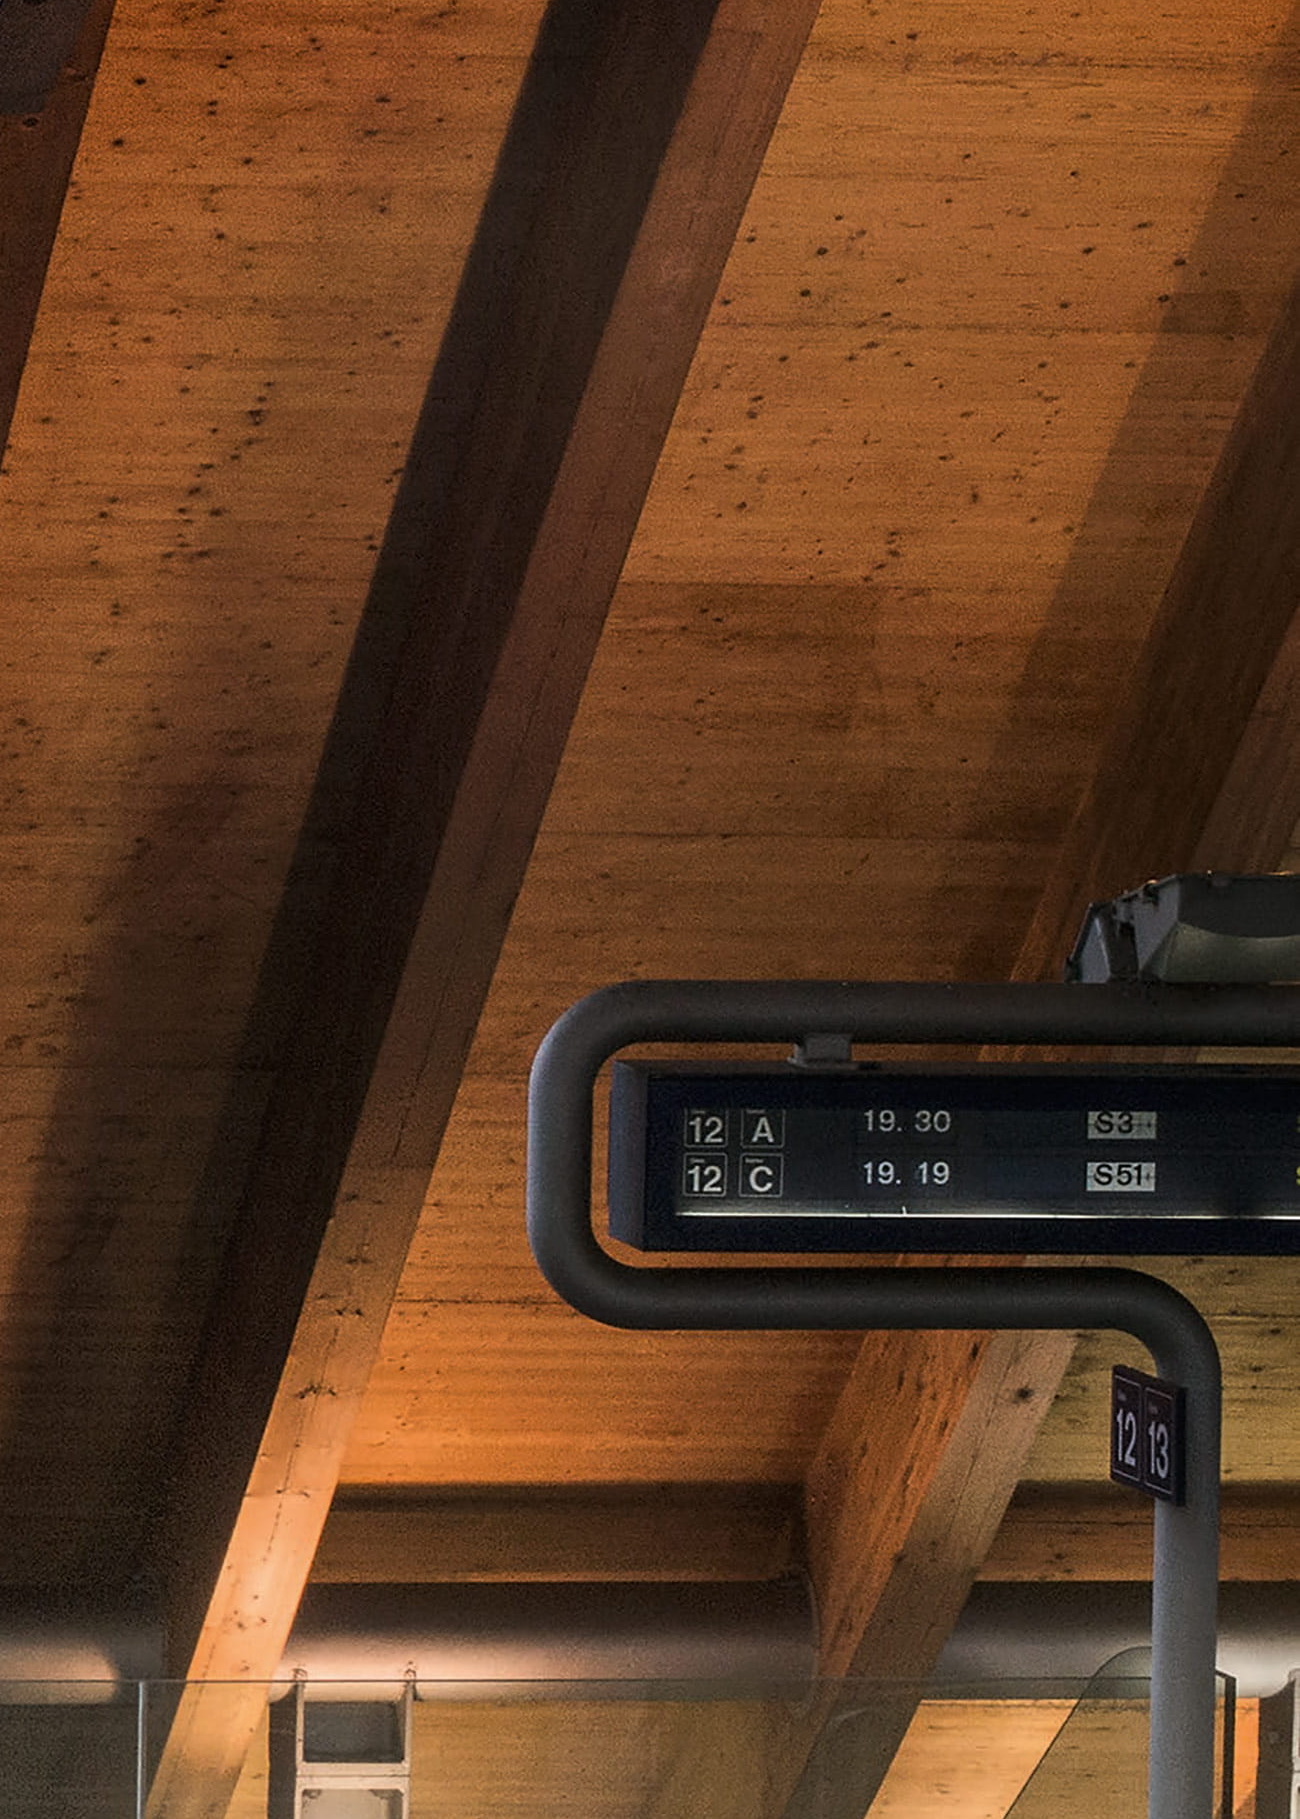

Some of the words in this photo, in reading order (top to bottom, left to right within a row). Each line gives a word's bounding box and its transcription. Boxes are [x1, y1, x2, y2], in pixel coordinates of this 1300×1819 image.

[688, 1116, 724, 1143] 12
[751, 1116, 775, 1143] A
[1094, 1111, 1134, 1134] S3
[686, 1164, 723, 1193] 12
[749, 1165, 774, 1193] C
[1094, 1163, 1143, 1186] S51
[1115, 1407, 1137, 1468] 12
[1147, 1420, 1169, 1480] 13
